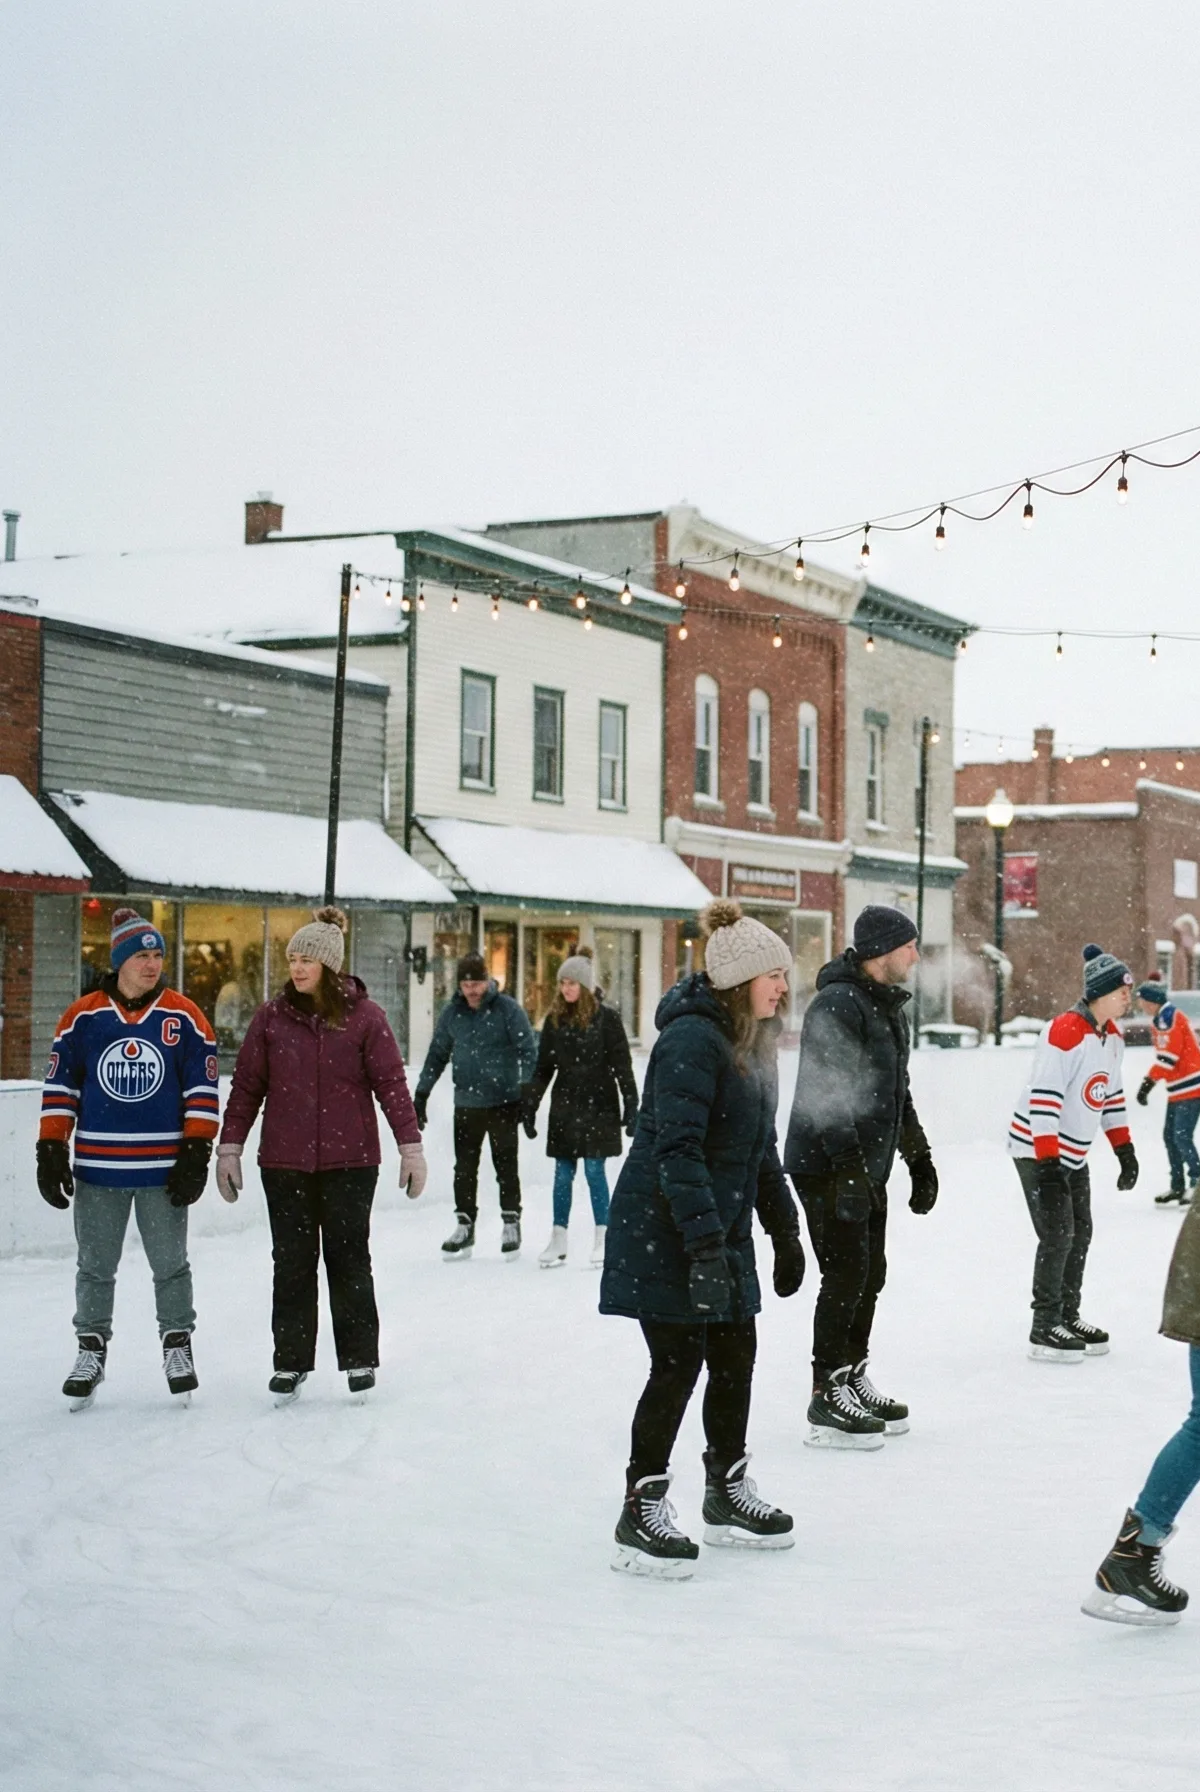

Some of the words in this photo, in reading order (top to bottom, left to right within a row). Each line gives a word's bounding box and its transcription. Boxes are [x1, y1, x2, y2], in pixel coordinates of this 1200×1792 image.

[161, 1017, 181, 1046] C
[46, 1052, 60, 1079] 7
[106, 1061, 156, 1092] OILERS
[205, 1055, 218, 1081] 9
